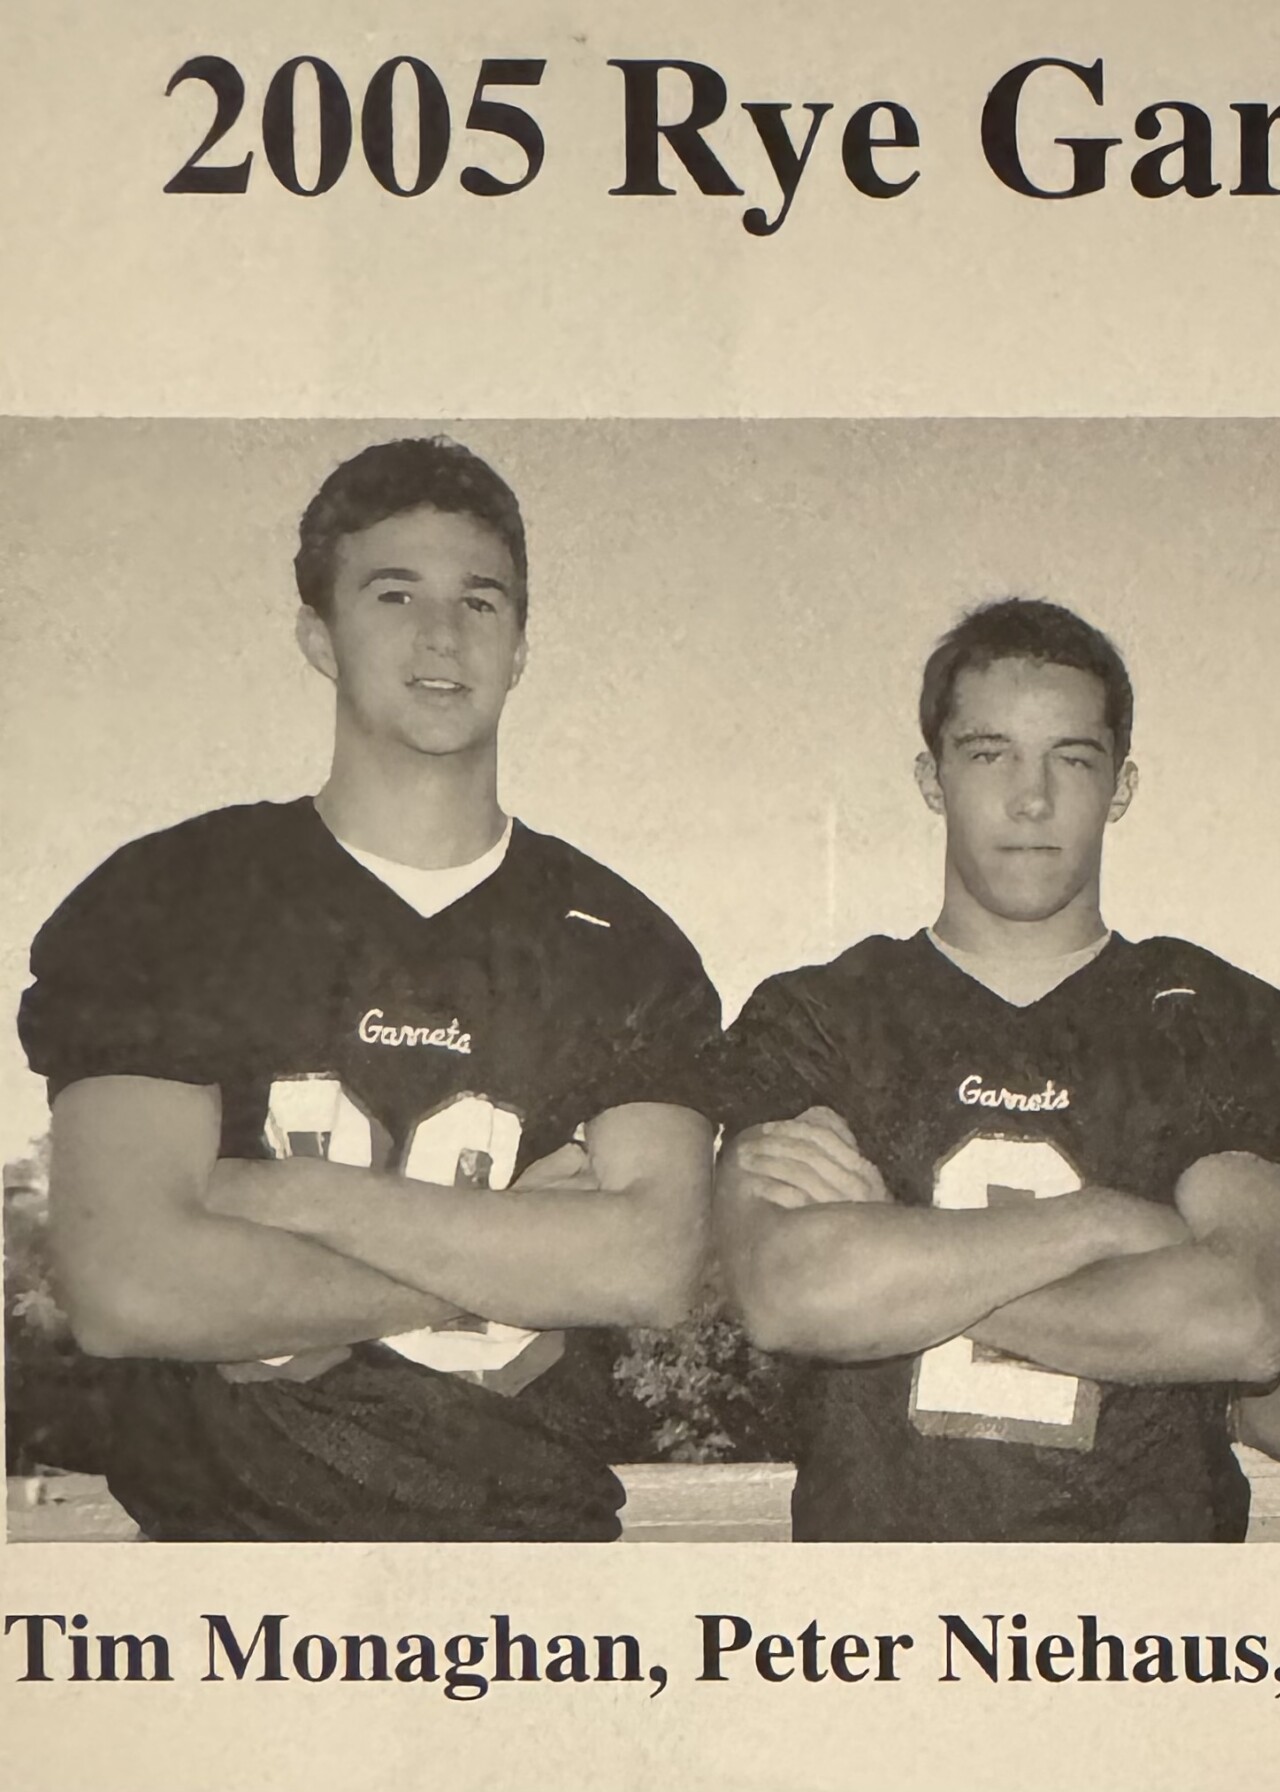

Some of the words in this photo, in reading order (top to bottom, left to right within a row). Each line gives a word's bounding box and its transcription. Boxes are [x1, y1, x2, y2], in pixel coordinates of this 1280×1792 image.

[164, 56, 546, 199] 2005
[607, 60, 920, 236] Rye
[357, 1007, 472, 1055] Garnets
[957, 1074, 1070, 1112] Garnets
[5, 1615, 173, 1683] Tim
[201, 1615, 666, 1700] Monaghan,
[696, 1616, 913, 1684] Peter
